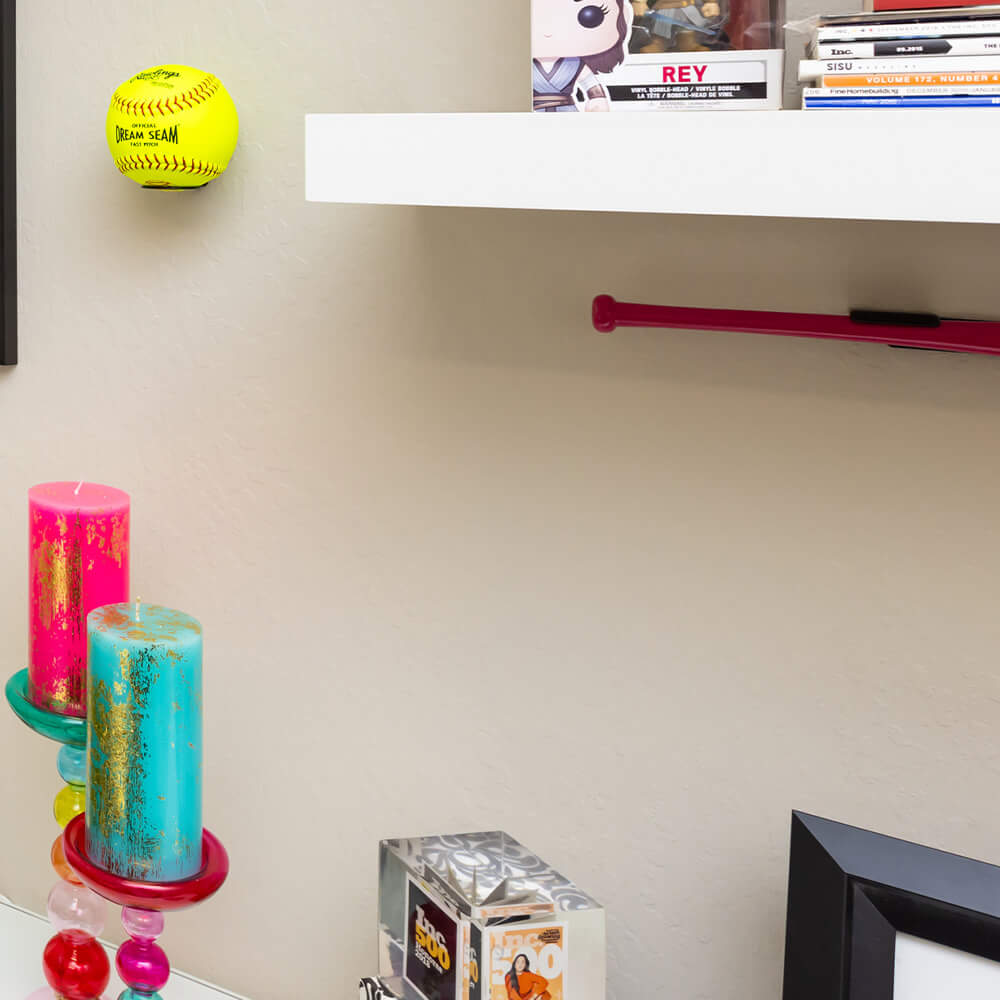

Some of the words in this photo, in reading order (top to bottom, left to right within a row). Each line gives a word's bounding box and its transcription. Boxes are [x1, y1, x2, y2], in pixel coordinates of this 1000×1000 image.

[831, 48, 854, 56] Inc.
[662, 65, 708, 83] REY
[827, 63, 853, 71] SISU
[866, 76, 910, 84] VOLUME
[940, 74, 988, 82] NUMBER
[115, 124, 145, 144] DREAM
[148, 125, 178, 144] SEAM
[416, 923, 451, 971] 500
